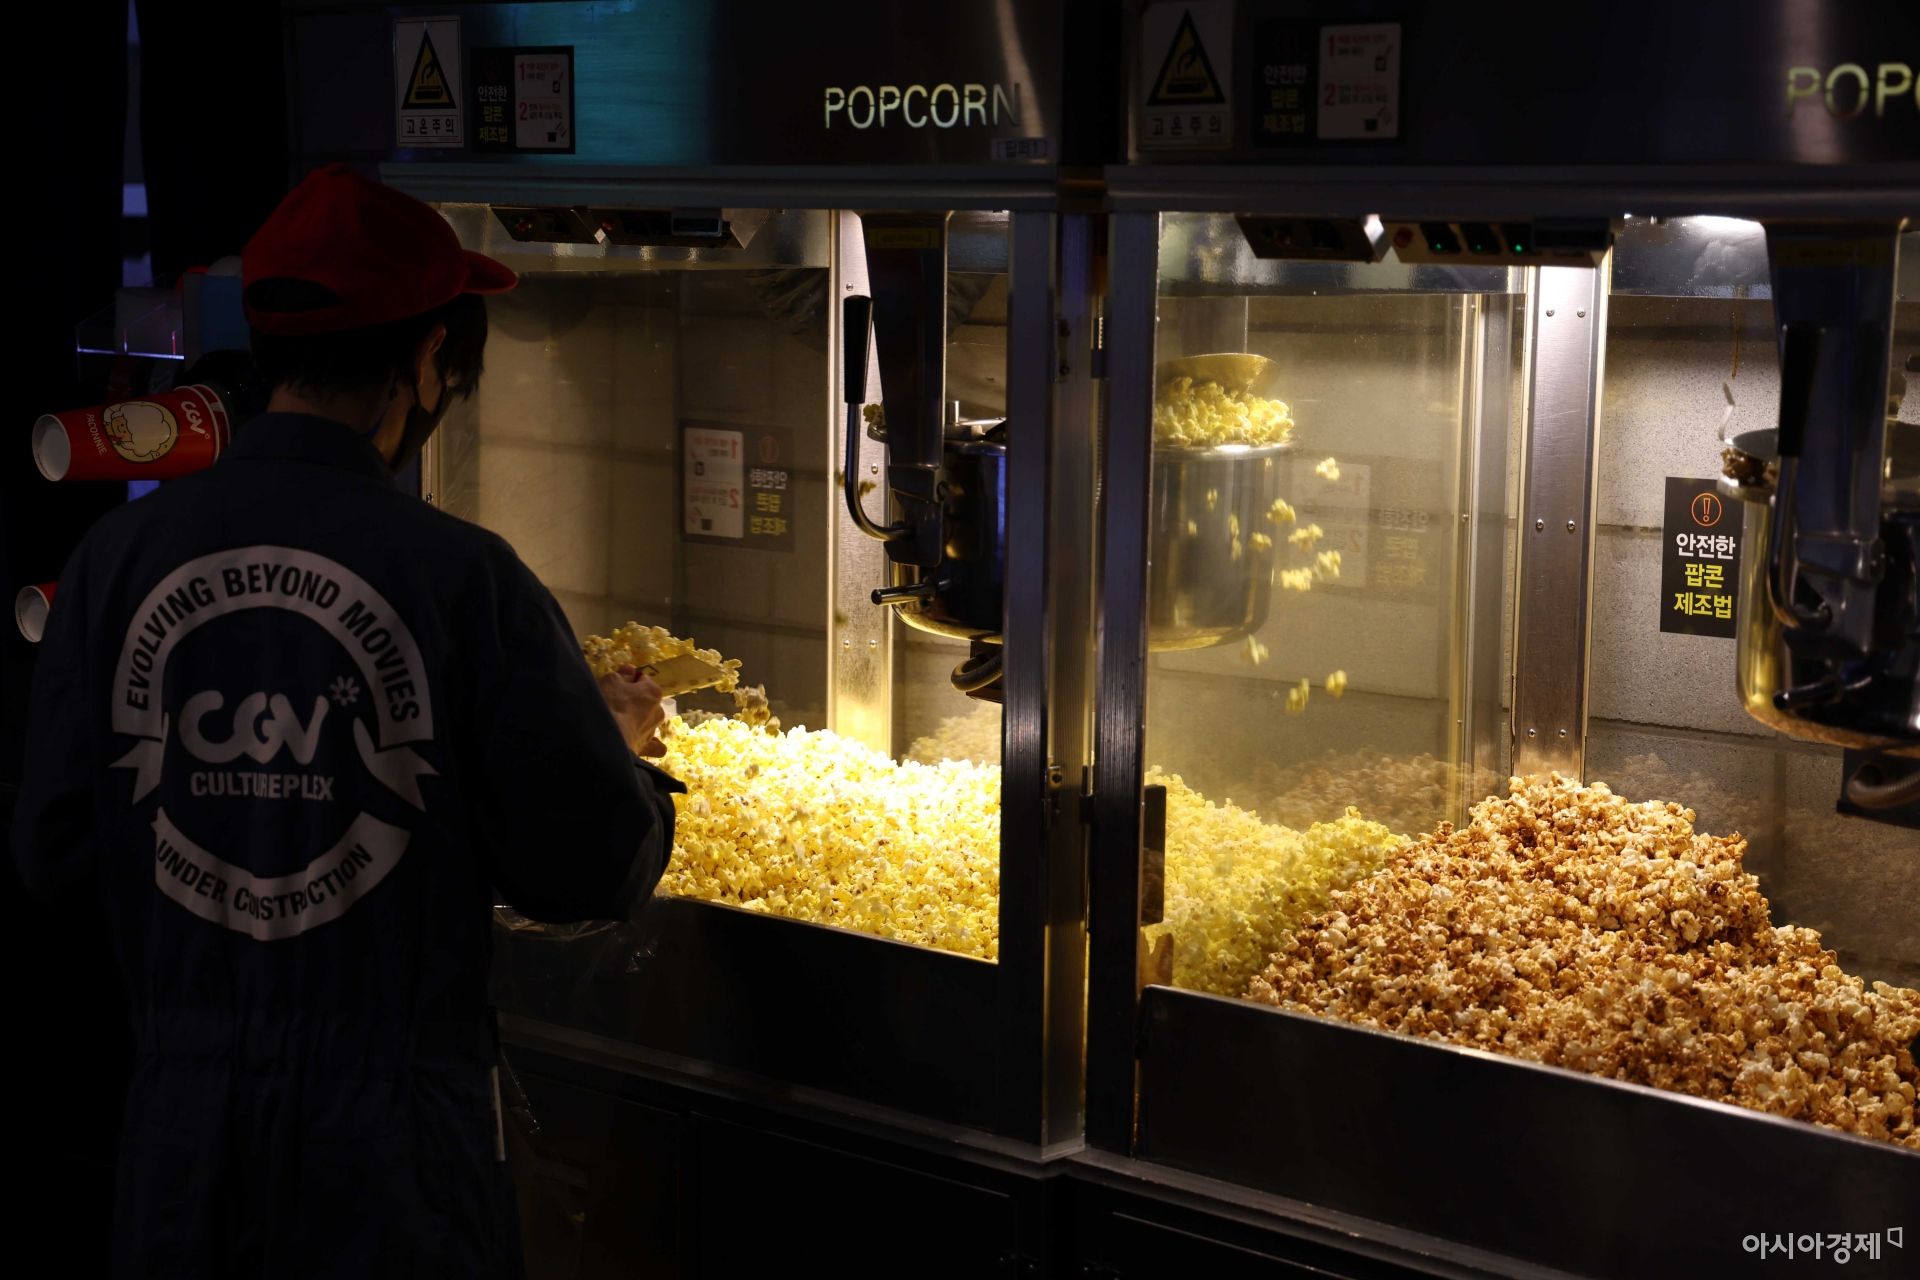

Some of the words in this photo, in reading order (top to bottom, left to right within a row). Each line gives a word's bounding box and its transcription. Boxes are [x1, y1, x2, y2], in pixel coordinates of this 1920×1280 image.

[477, 86, 508, 101] 안전한
[1324, 84, 1337, 107] 2
[1786, 62, 1920, 119] POP
[482, 104, 505, 123] 팝콘
[519, 103, 528, 121] 2
[824, 82, 1020, 130] POPCORN
[405, 118, 455, 135] 고온주의
[479, 126, 509, 143] 제조법
[1151, 116, 1221, 136] 고온주의
[180, 400, 207, 435] CGV
[1676, 533, 1736, 560] 안전한
[1684, 563, 1725, 589] 팝콘
[1673, 592, 1733, 620] 제조법
[126, 576, 216, 711] EVOLVING
[221, 563, 341, 609] BEYOND
[337, 599, 420, 723] MOVIES
[178, 690, 330, 766] CGV
[156, 839, 229, 904] UNDER
